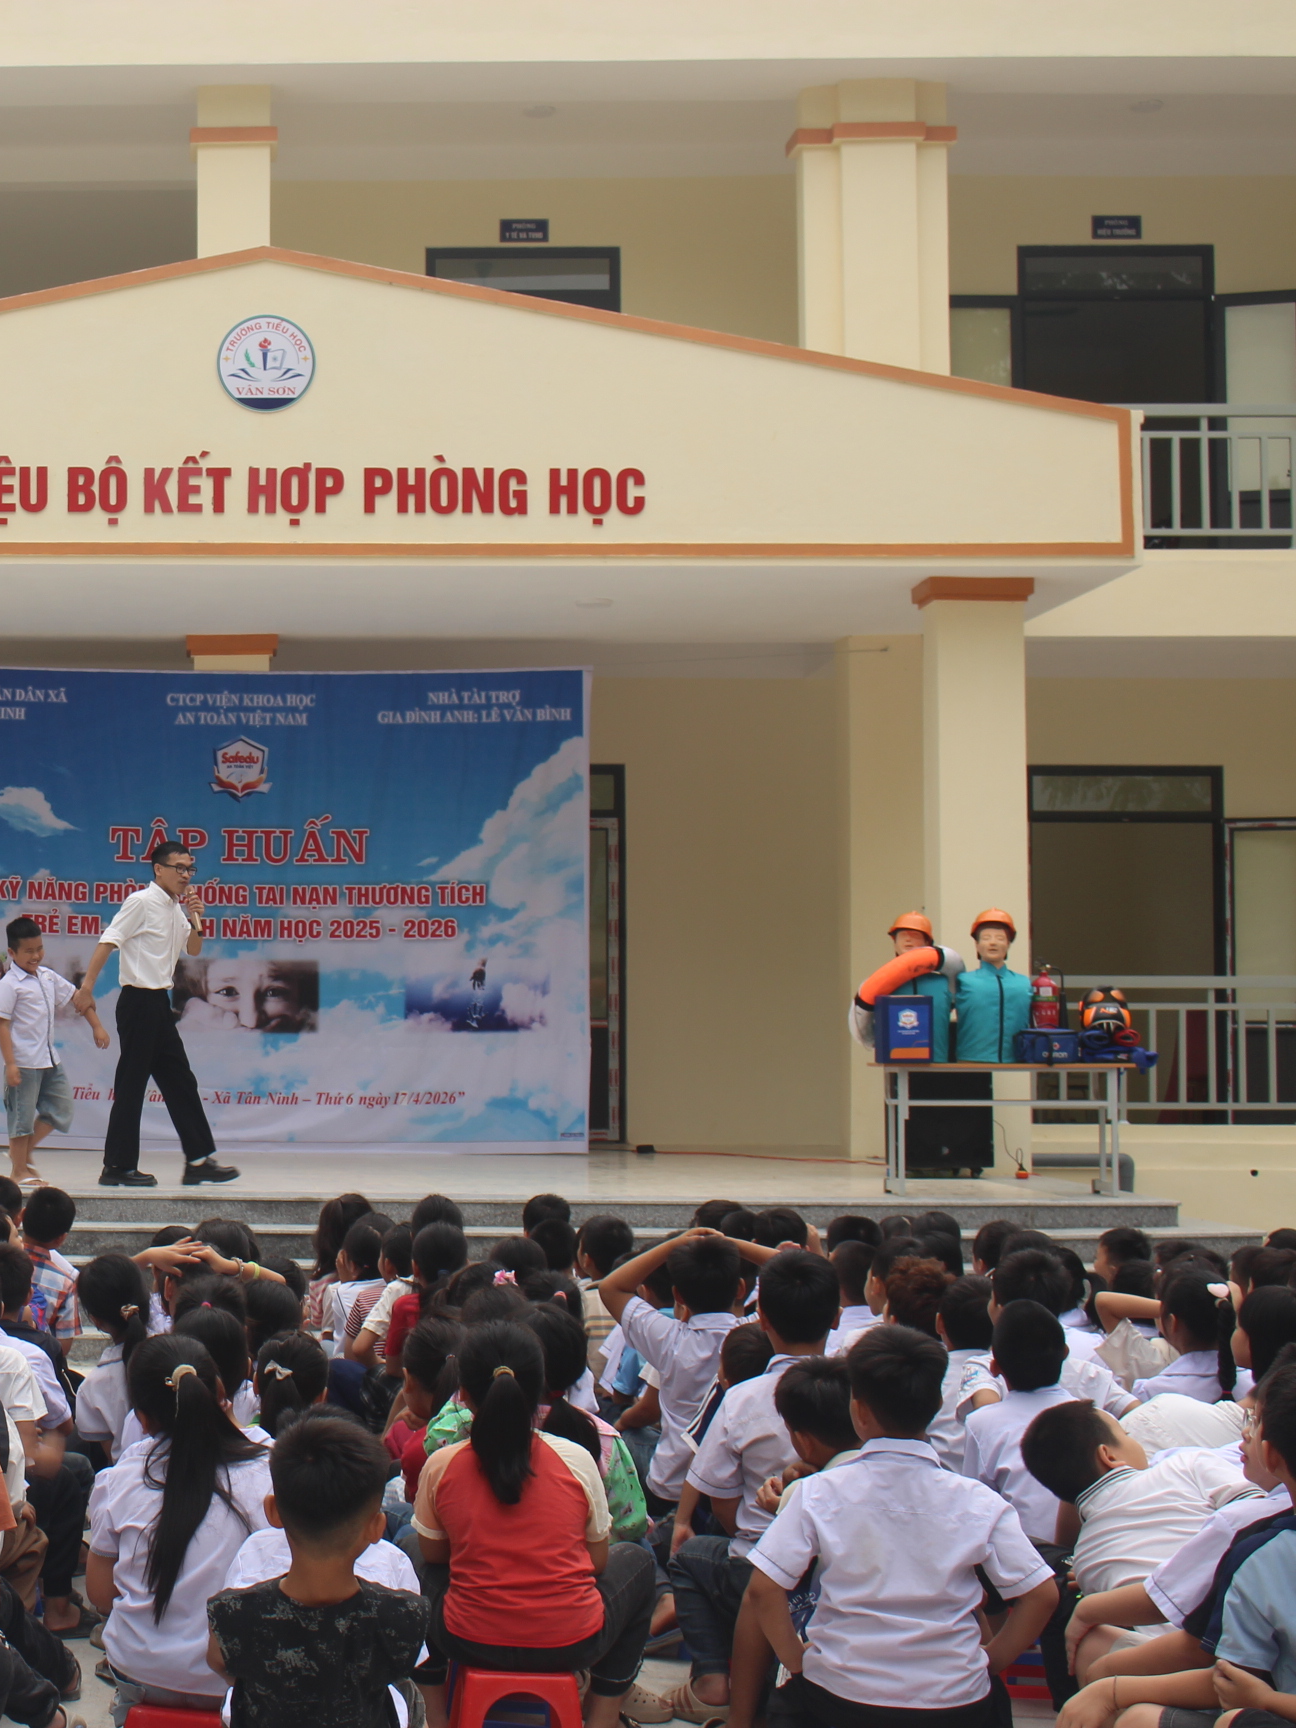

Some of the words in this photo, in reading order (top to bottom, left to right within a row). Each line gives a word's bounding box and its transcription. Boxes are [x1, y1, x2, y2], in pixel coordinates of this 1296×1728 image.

[226, 322, 262, 353] TRƯỜNG
[266, 319, 289, 335] TIỂU
[289, 332, 307, 353] HỌC
[235, 385, 264, 396] VÂN
[267, 386, 297, 396] SƠN
[68, 456, 127, 524] BỘ
[145, 452, 231, 513] KẾT
[248, 463, 344, 525] HỢP
[364, 456, 527, 515] PHÒNG
[550, 468, 644, 525] HỌC
[15, 685, 45, 702] DÂN
[47, 687, 68, 703] XÃ
[166, 693, 204, 706] CTCP
[206, 690, 240, 709] VIỆN
[242, 694, 284, 707] KHOA
[285, 694, 317, 710] HỌC
[427, 688, 459, 705] NHÀ
[461, 688, 487, 704] TÀI
[489, 689, 521, 706] TRỢ
[174, 712, 196, 725] AN
[198, 709, 237, 725] TOÀN
[239, 709, 273, 727] VIỆT
[275, 712, 308, 726] NAM
[377, 710, 404, 724] GIA
[405, 707, 441, 724] ĐÌNH
[443, 710, 478, 724] ANH:
[481, 707, 501, 723] LÊ
[503, 706, 533, 722] VĂN
[536, 705, 572, 721] BÌNH
[221, 751, 259, 764] Safedu
[221, 814, 369, 865] HUẤN
[27, 877, 88, 902] NĂNG
[254, 884, 285, 907] TAI
[291, 885, 339, 911] NẠN
[344, 883, 431, 907] THƯƠNG
[436, 880, 486, 906] TÍCH
[221, 914, 273, 939] NĂM
[278, 918, 322, 944] HỌC
[329, 918, 382, 940] 2025
[403, 918, 457, 940] 2026
[211, 1091, 232, 1104] Xã
[236, 1091, 261, 1105] Tân
[264, 1092, 299, 1106] Ninh
[316, 1091, 344, 1106] Thứ
[345, 1093, 354, 1106] 6
[358, 1093, 391, 1109] ngày
